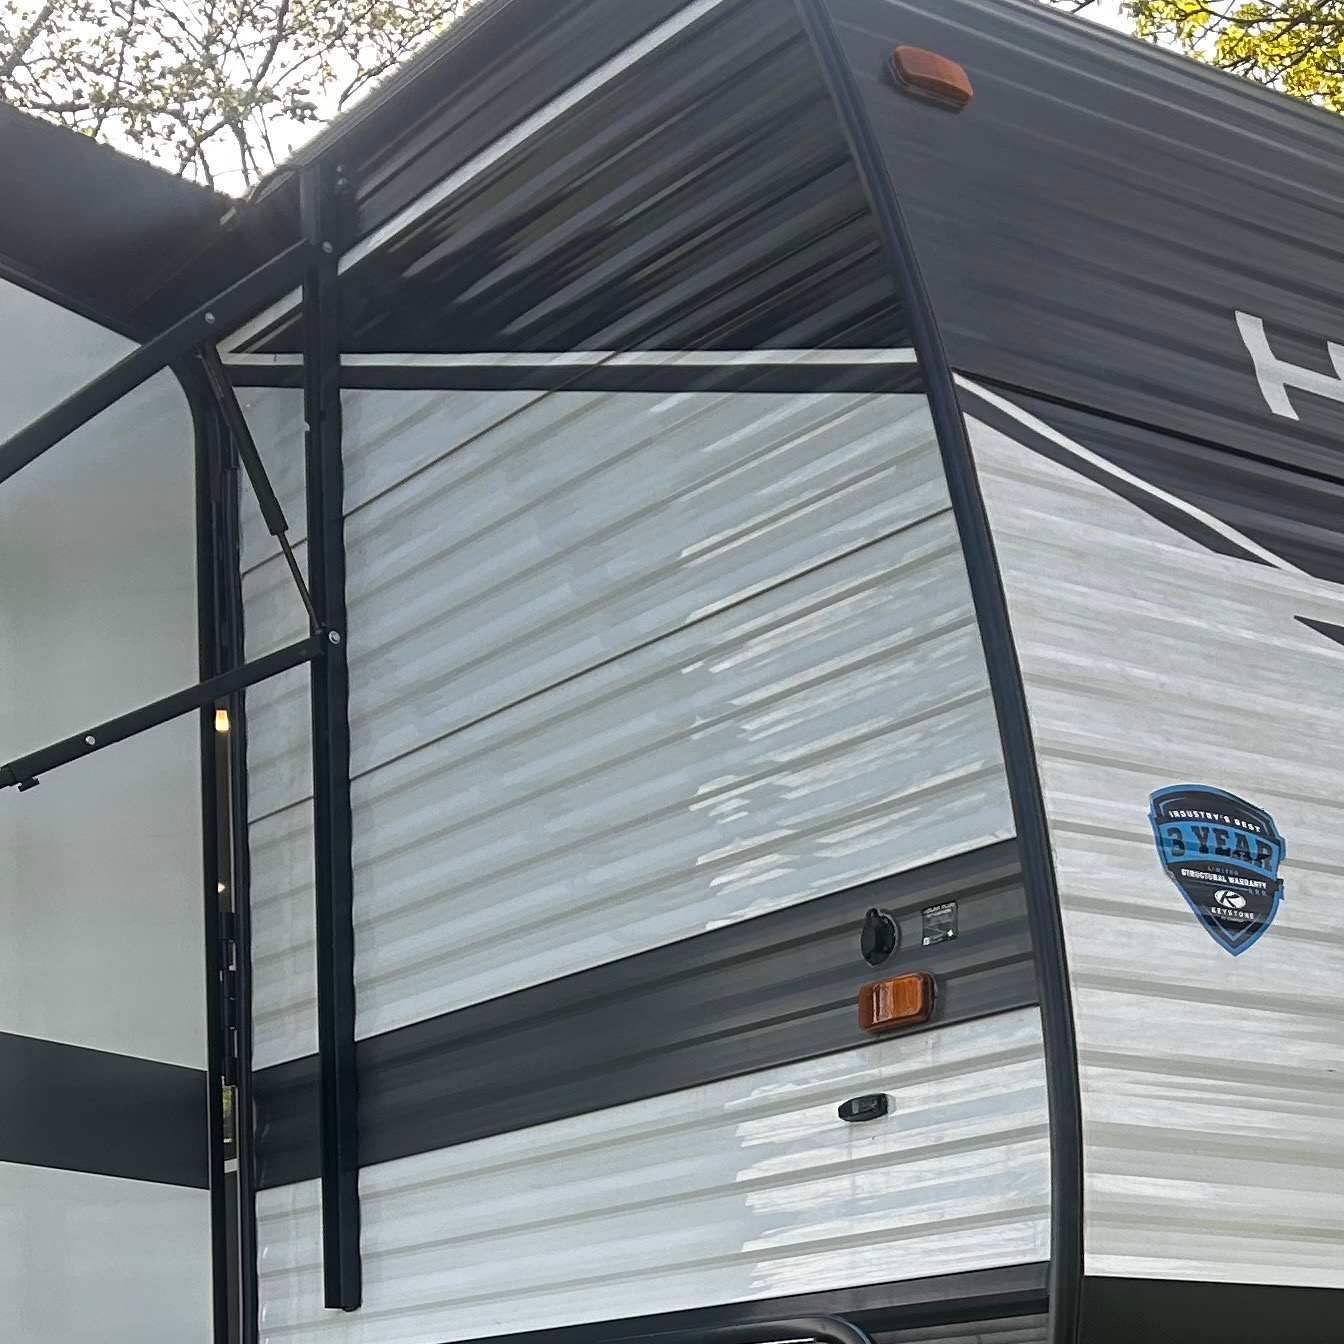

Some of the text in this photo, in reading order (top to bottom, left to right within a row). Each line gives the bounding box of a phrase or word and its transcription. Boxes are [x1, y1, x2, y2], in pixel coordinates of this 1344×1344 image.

[1167, 826, 1273, 872] 3 YEAR
[1211, 906, 1254, 919] KEYSTONE
